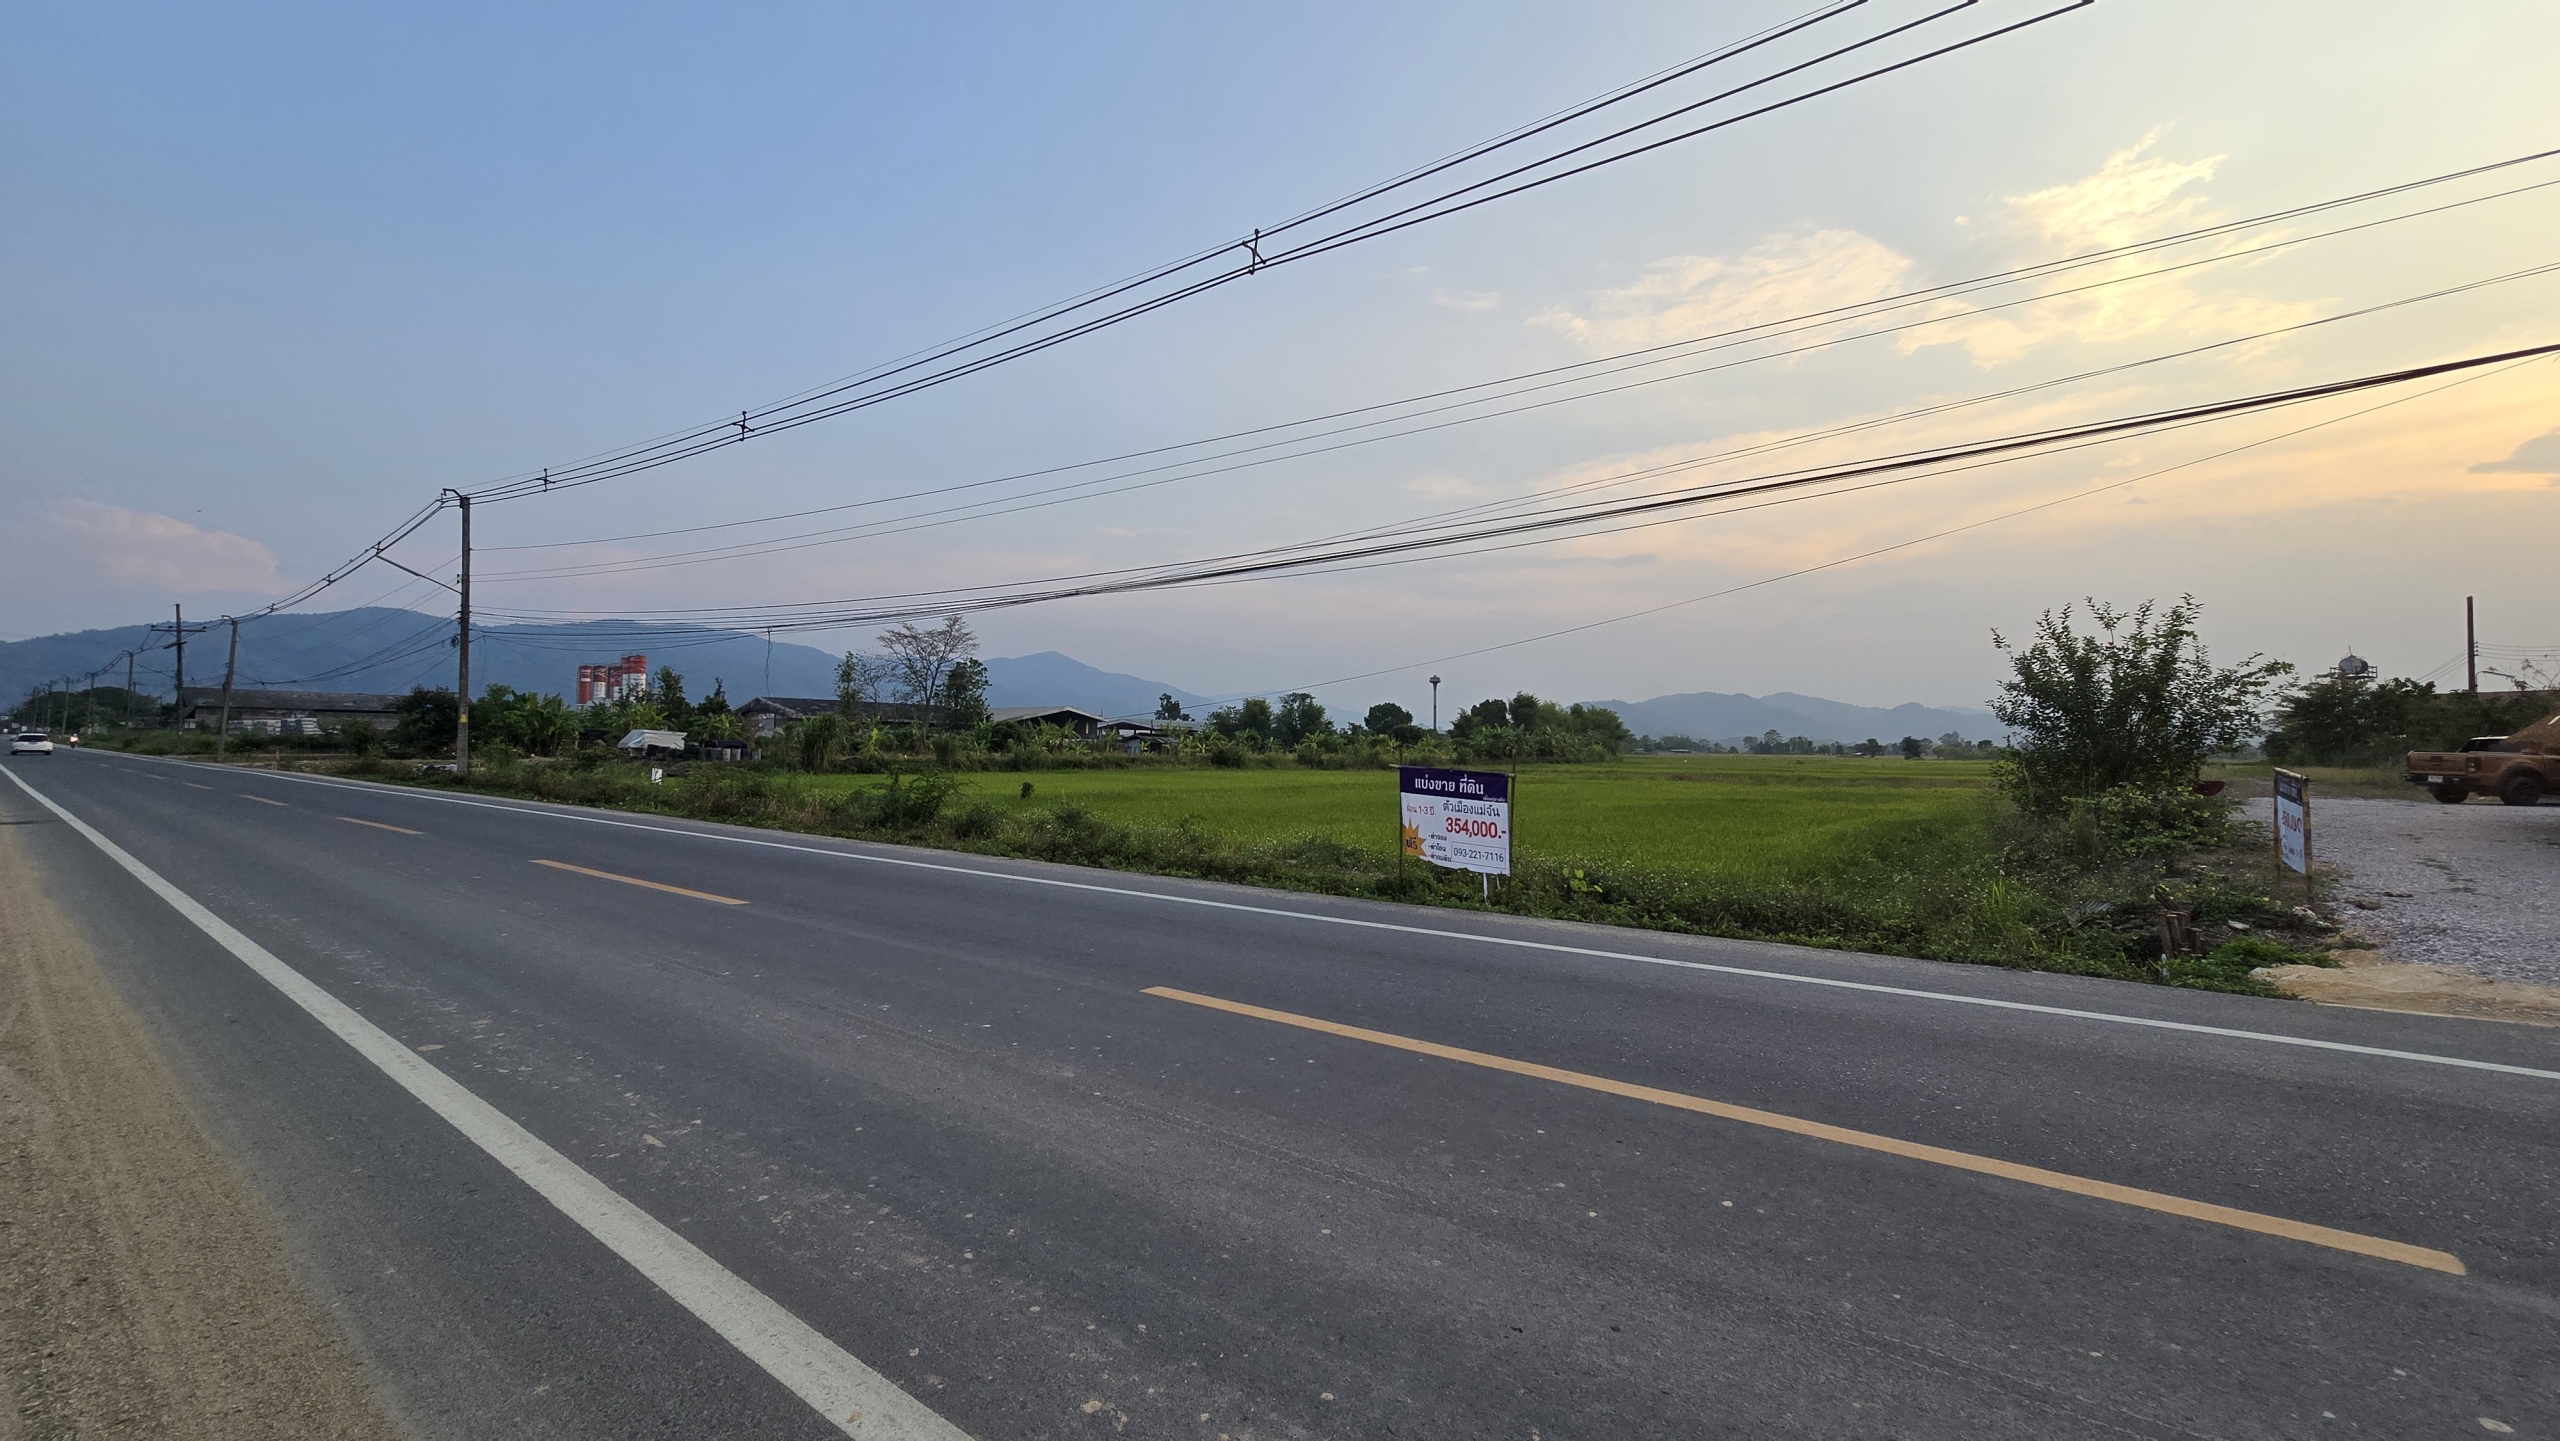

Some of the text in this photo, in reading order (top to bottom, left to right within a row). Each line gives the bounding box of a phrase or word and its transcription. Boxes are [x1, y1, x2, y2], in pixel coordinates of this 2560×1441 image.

[1415, 773, 1484, 795] แบ่งขาย ที่ดิน
[1418, 805, 1428, 815] 1-3
[1443, 800, 1500, 817] ตัวเมืองแม่จัน
[1445, 816, 1507, 839] 354,000.-
[1406, 836, 1418, 850] ฟรี
[1453, 847, 1504, 862] 093-221-7116
